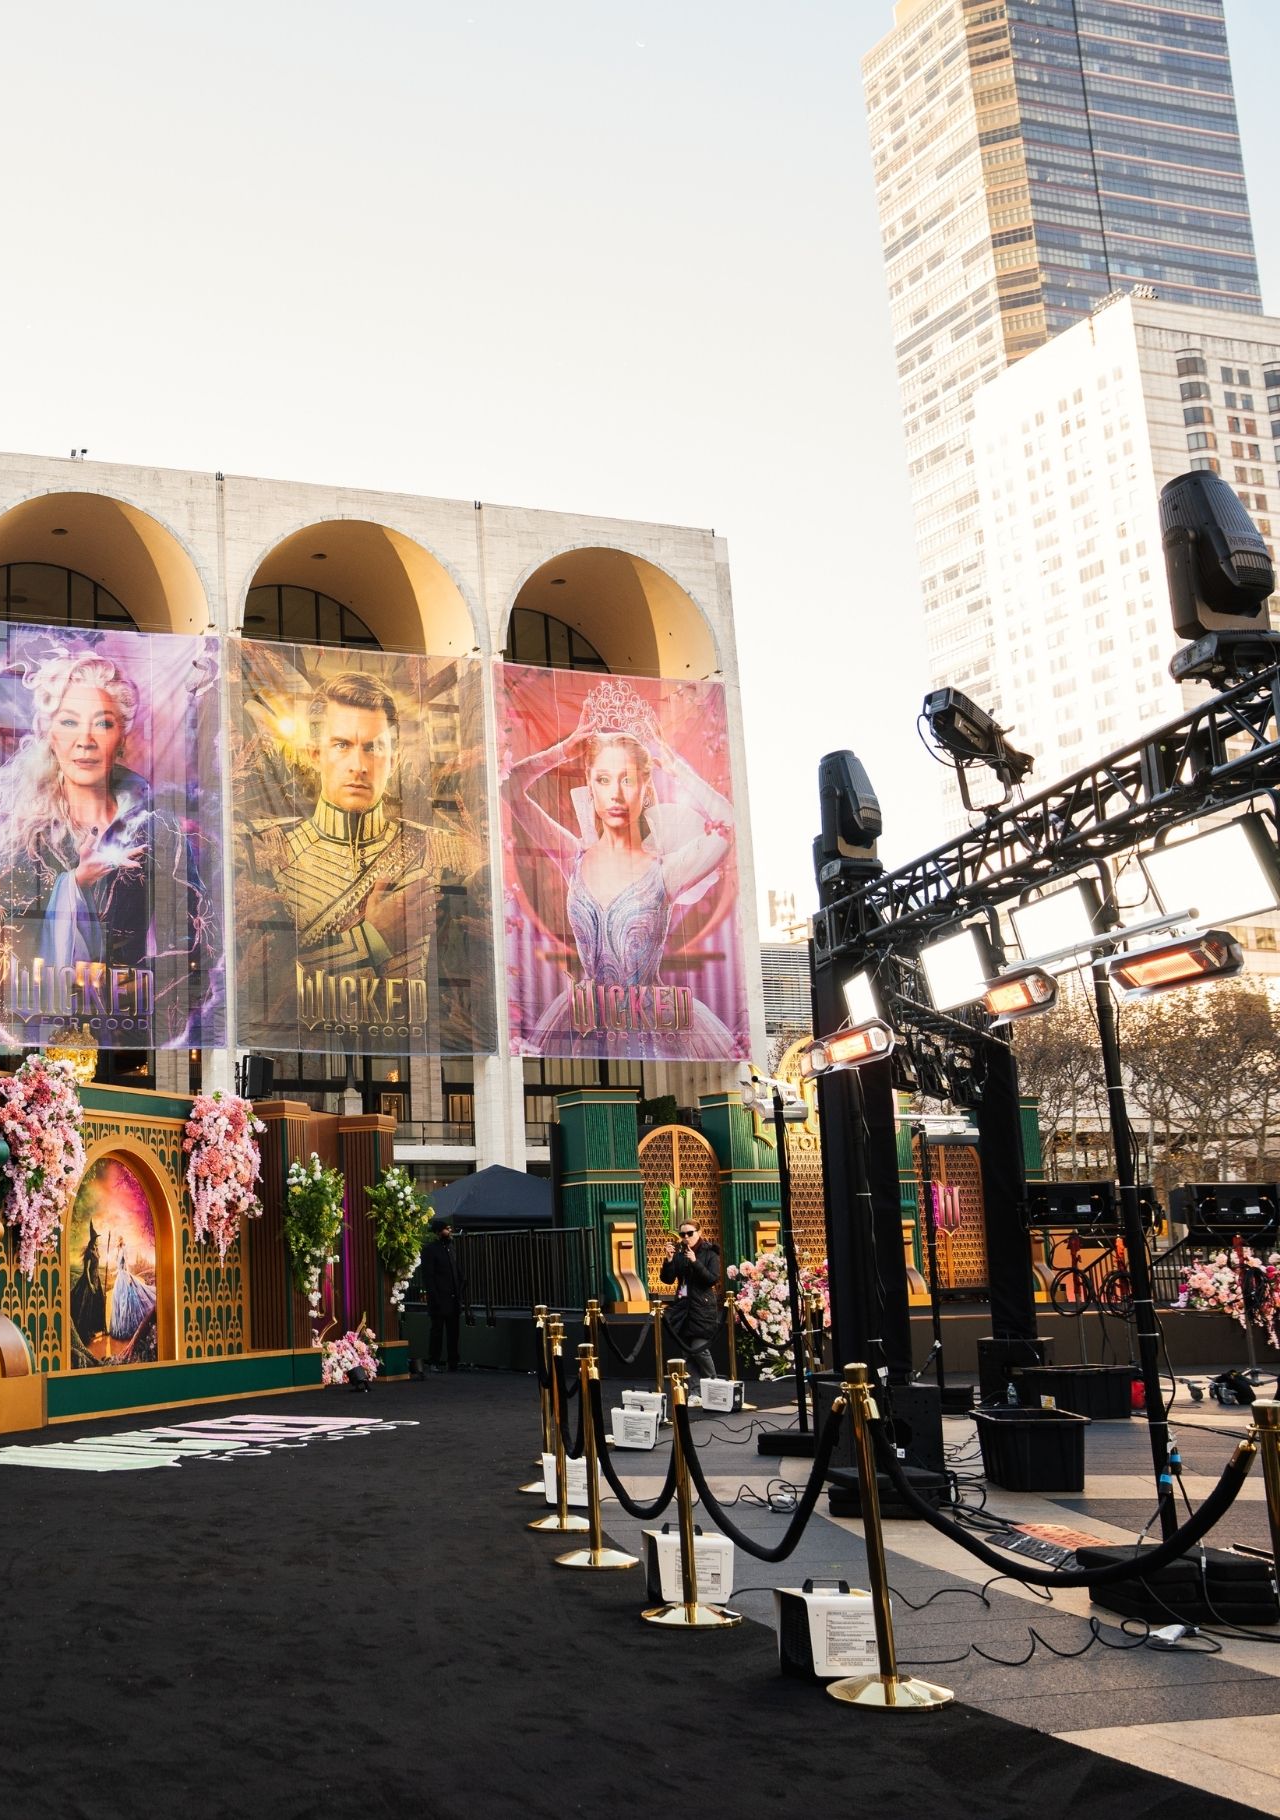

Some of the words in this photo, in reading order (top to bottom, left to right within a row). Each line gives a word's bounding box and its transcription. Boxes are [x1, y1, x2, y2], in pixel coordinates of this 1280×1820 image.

[10, 951, 155, 1024] WICKED
[296, 961, 428, 1031] WICKED
[564, 971, 694, 1038] WICKED
[39, 1016, 81, 1030] FOR
[90, 1017, 149, 1030] GOOD
[323, 1023, 360, 1037] FOR
[368, 1025, 423, 1037] GOOD
